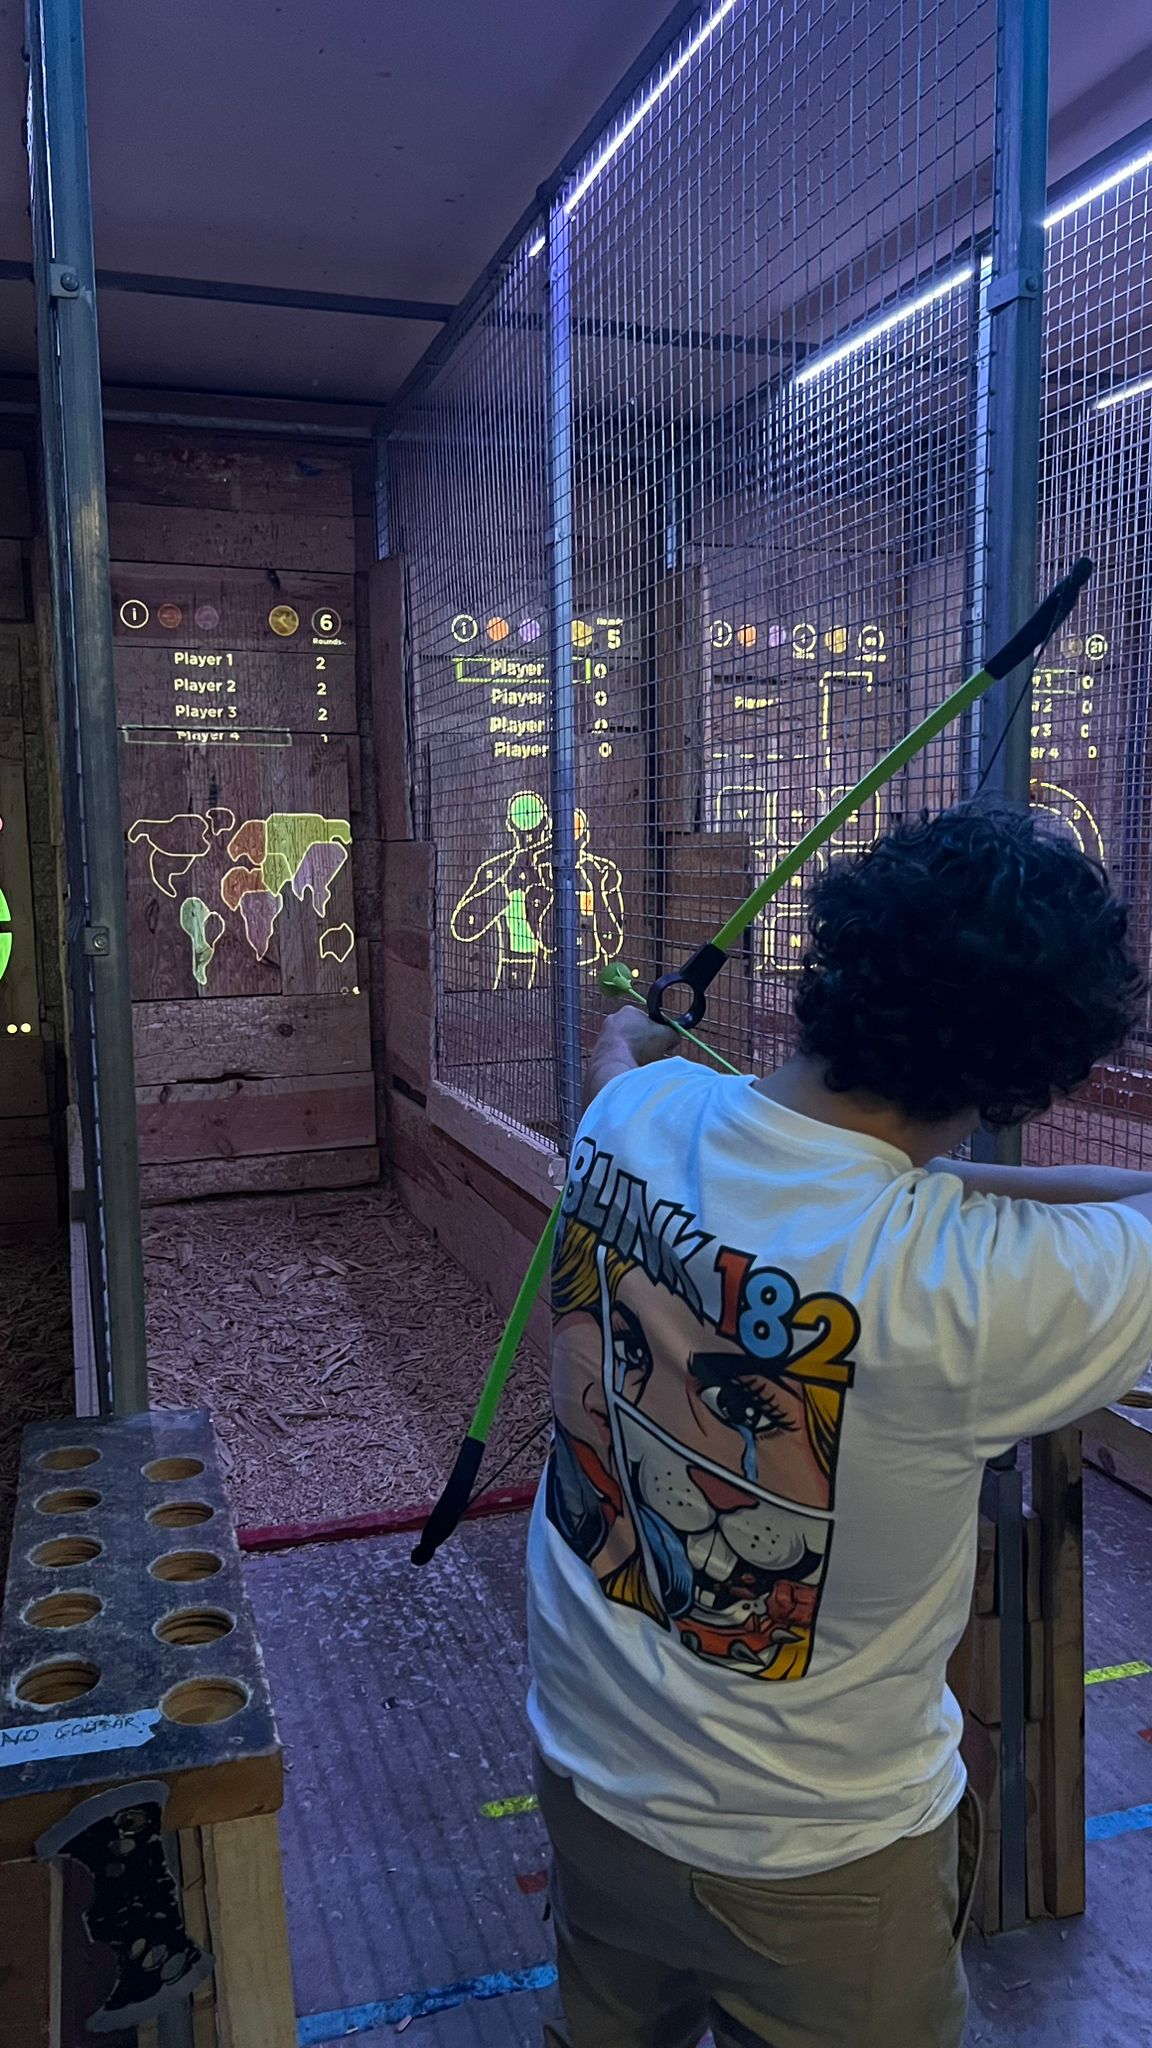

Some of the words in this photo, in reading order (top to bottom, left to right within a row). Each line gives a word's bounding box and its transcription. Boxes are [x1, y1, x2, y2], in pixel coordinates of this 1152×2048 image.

[320, 613, 333, 631] 6
[174, 651, 222, 668] Player
[226, 653, 233, 667] 1
[316, 656, 326, 670] 2
[490, 659, 545, 679] Player
[594, 663, 608, 679] 0
[174, 678, 222, 694] Player
[226, 679, 236, 693] 2
[316, 682, 327, 696] 2
[175, 704, 223, 720] Player
[228, 706, 238, 718] 3
[317, 708, 328, 721] 2
[176, 731, 224, 743] Player
[598, 742, 613, 758] 0
[560, 1136, 716, 1326] BLINK
[713, 1244, 861, 1388] 182
